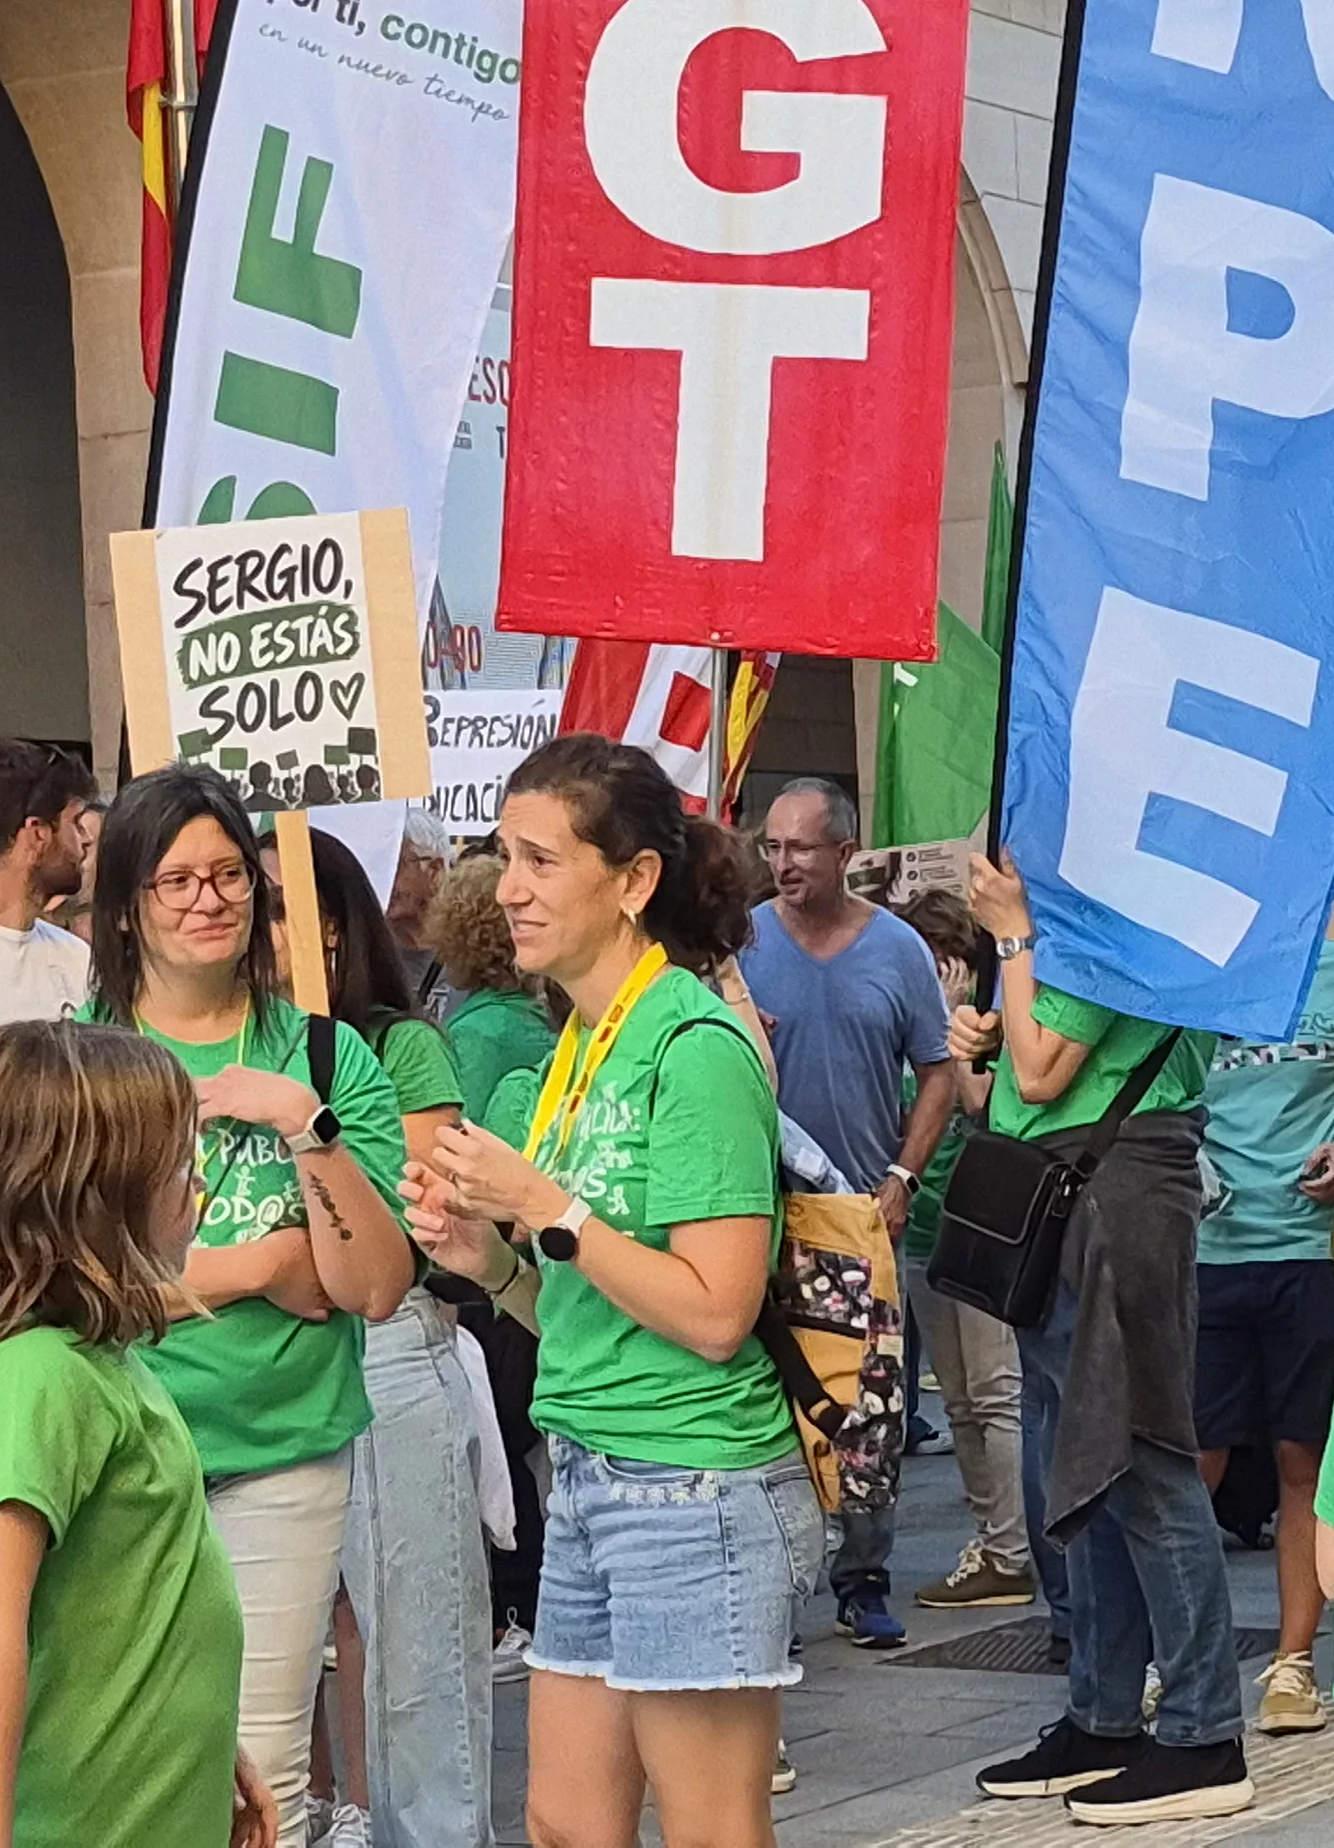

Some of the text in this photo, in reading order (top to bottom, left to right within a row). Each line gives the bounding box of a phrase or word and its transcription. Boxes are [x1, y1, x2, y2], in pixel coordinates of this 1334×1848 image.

[297, 38, 328, 58] un
[337, 53, 414, 86] nuevo
[422, 73, 511, 123] tiempo
[379, 13, 521, 85] contigo
[173, 538, 353, 629] SERGIO,
[188, 604, 354, 682] NO ESTÁS
[198, 670, 325, 745] SOLO
